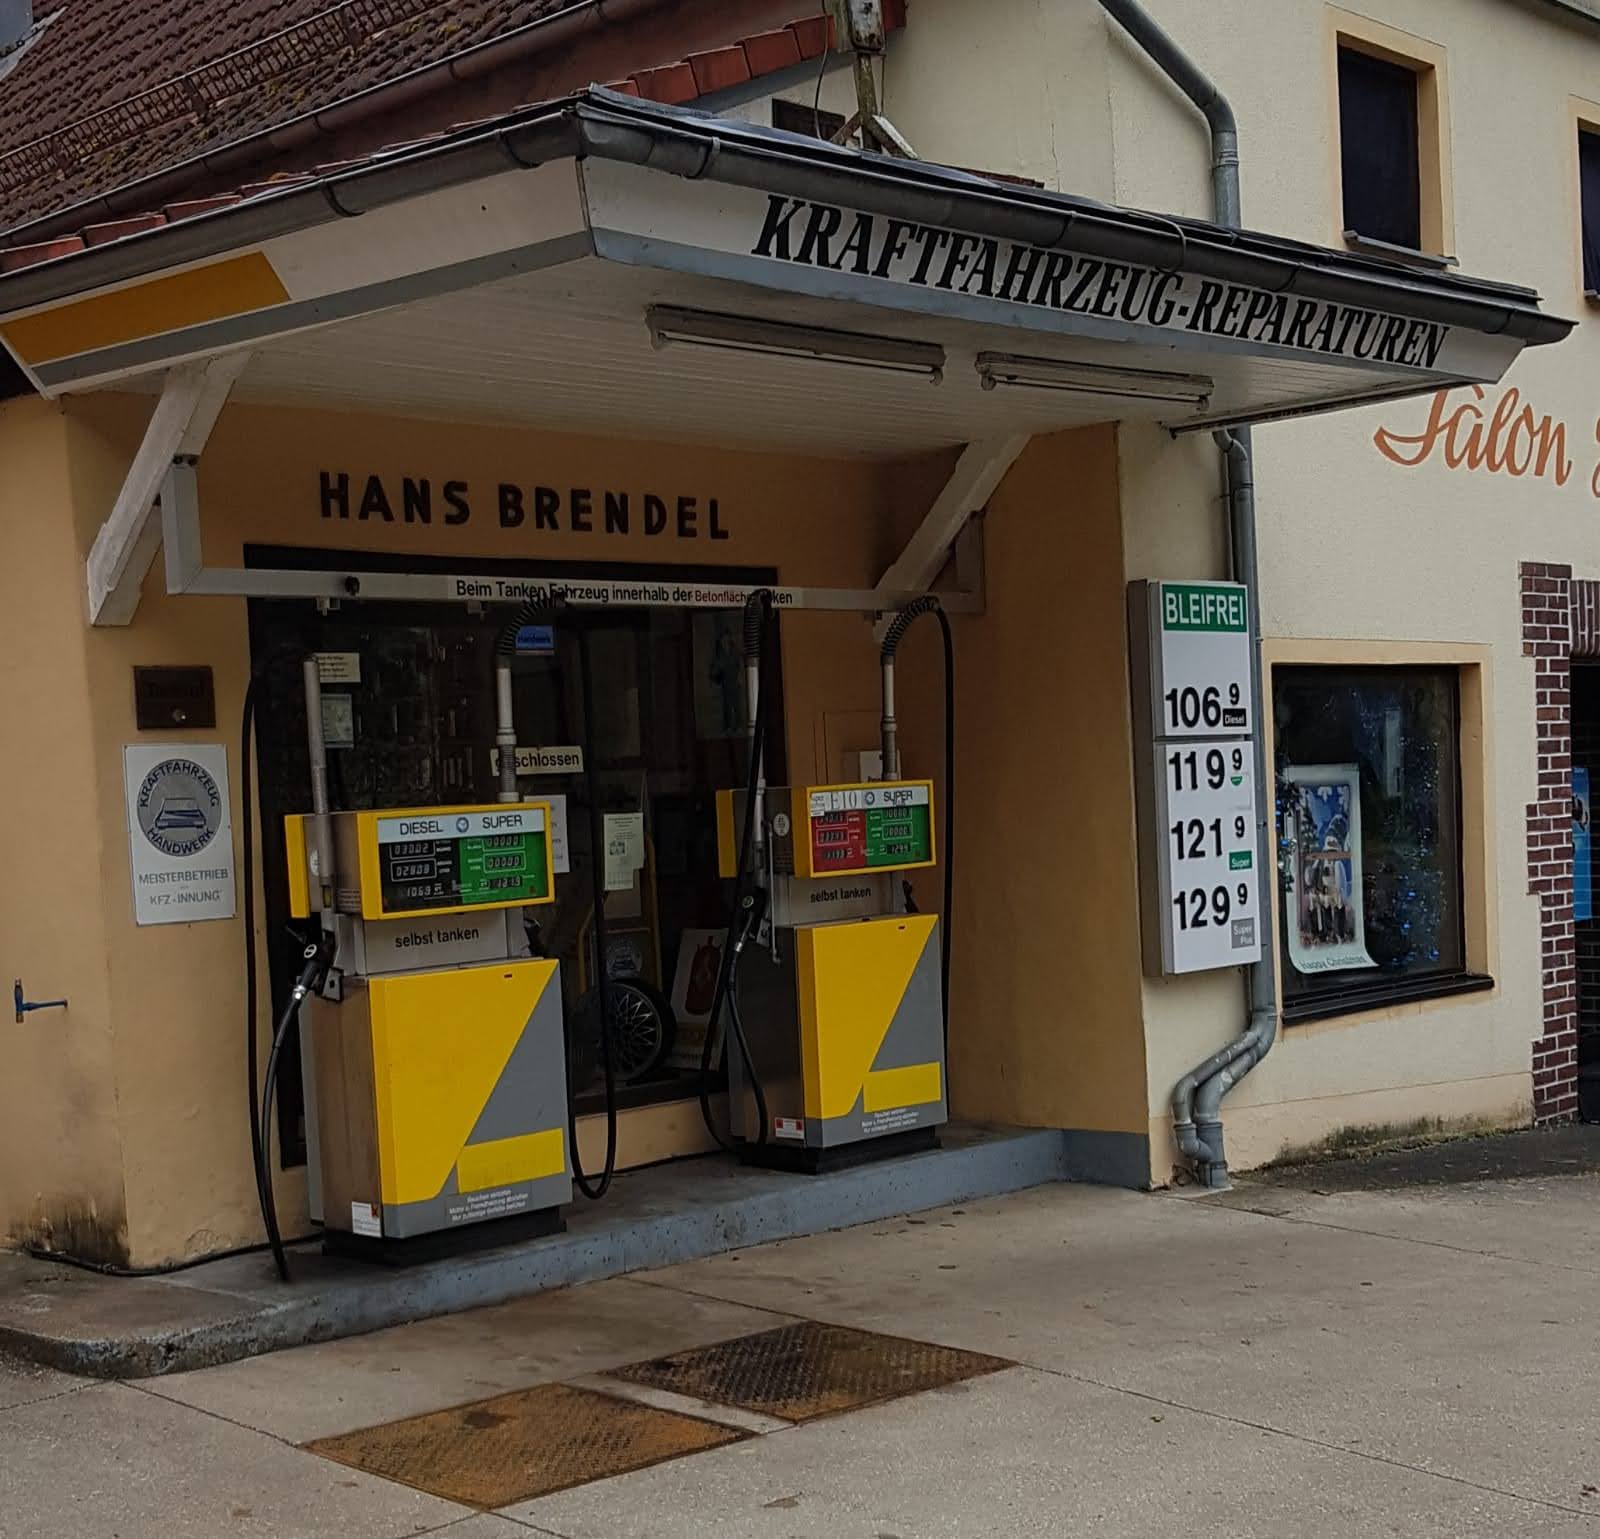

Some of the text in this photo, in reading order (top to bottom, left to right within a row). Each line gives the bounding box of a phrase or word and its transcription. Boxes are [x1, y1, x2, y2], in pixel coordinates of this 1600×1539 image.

[751, 195, 1449, 369] KRAFTFAHRZEUG-REPARATUREN
[319, 471, 729, 540] HANS BRENDEL
[456, 580, 492, 597] Beim
[496, 581, 547, 599] Tanken
[548, 582, 610, 604] Fahrzeug
[611, 584, 670, 602] innerhalb
[672, 587, 693, 603] der
[695, 590, 753, 603] Betonfläch
[1165, 592, 1244, 625] BLEIFREI
[1165, 682, 1240, 728] 106 9
[1224, 714, 1245, 725] Diesel
[495, 752, 579, 771] schlossen
[1168, 747, 1243, 791] 119 9
[139, 759, 220, 807] KRAFTFAHRZEUG
[883, 790, 913, 801] SUPER
[400, 814, 523, 835] DIESEL SUPER
[1171, 815, 1246, 860] 121 9
[147, 827, 214, 854] HANDWERK
[138, 868, 229, 885] MEISTERBETRIEB
[811, 886, 872, 903] selbst tanken
[1174, 882, 1248, 931] 129 9
[395, 927, 480, 948] selbst tanken
